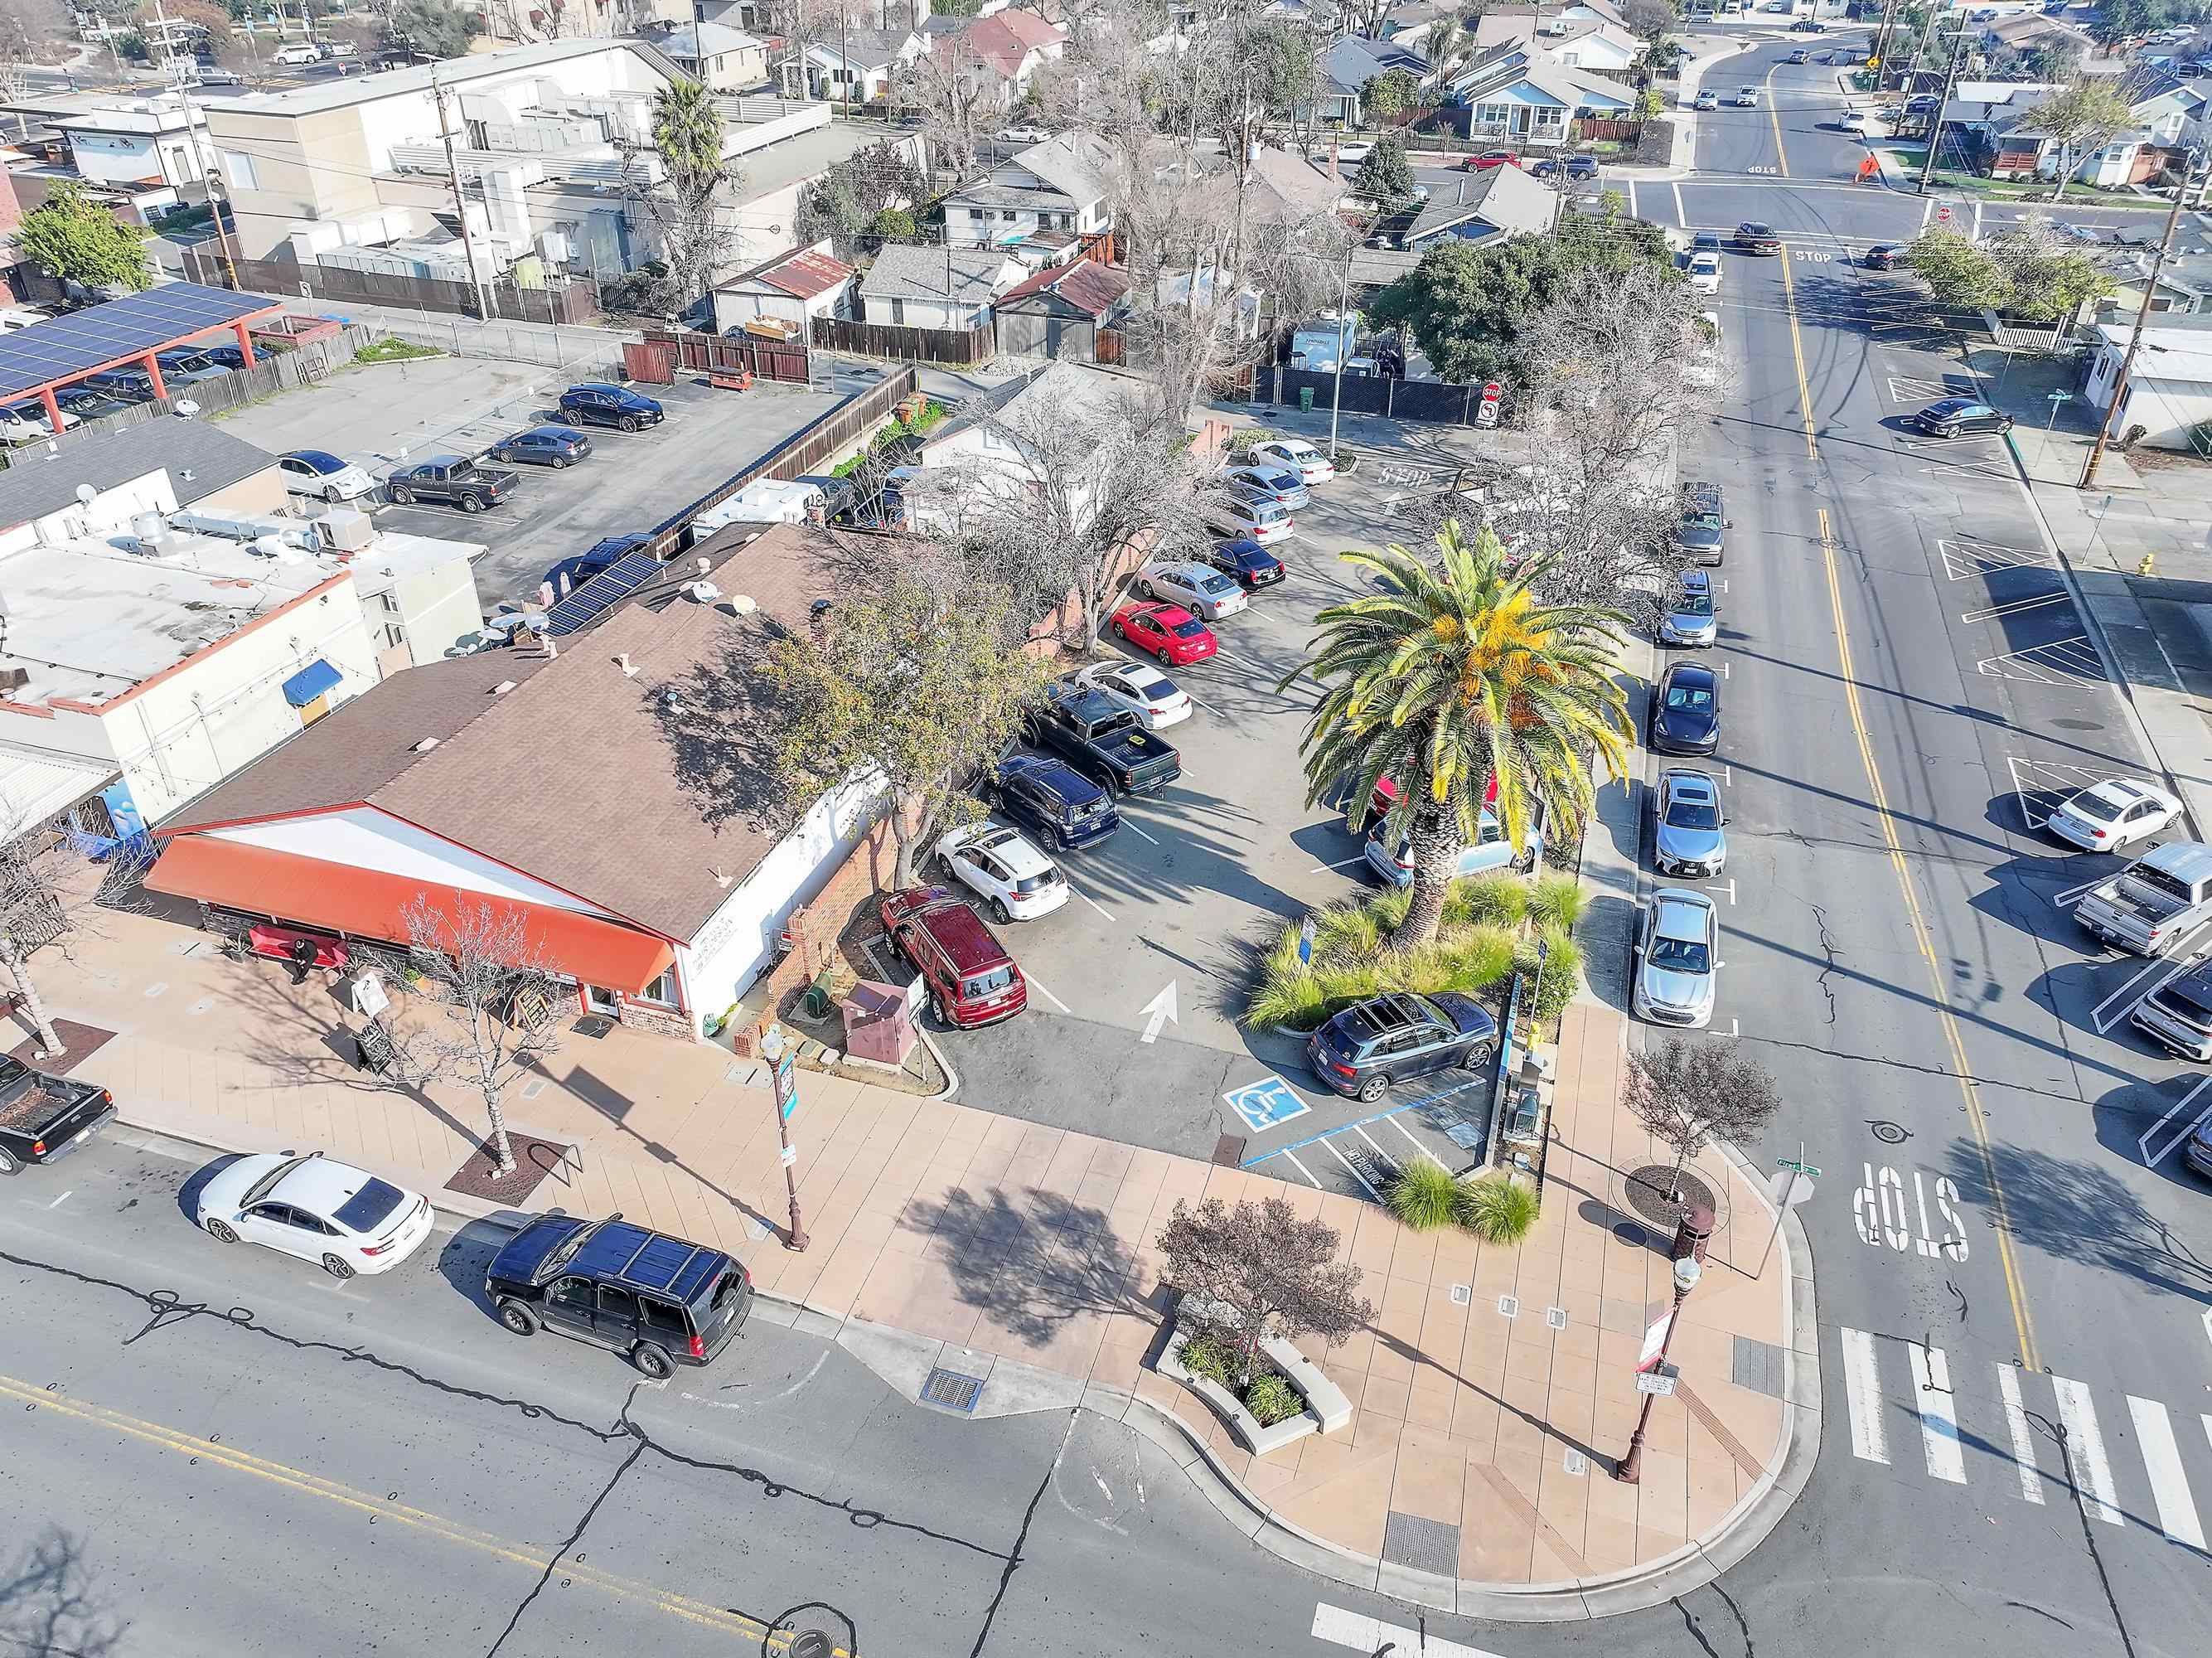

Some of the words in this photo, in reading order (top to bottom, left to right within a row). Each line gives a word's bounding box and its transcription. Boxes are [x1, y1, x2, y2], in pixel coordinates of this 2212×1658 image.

[1748, 166, 1777, 174] STOP
[1795, 251, 1831, 264] STOP
[1484, 388, 1501, 398] STOP
[1378, 467, 1431, 490] STOP
[1343, 1149, 1360, 1161] NO
[1353, 1157, 1384, 1184] PARKING
[1853, 1161, 1969, 1263] STOP
